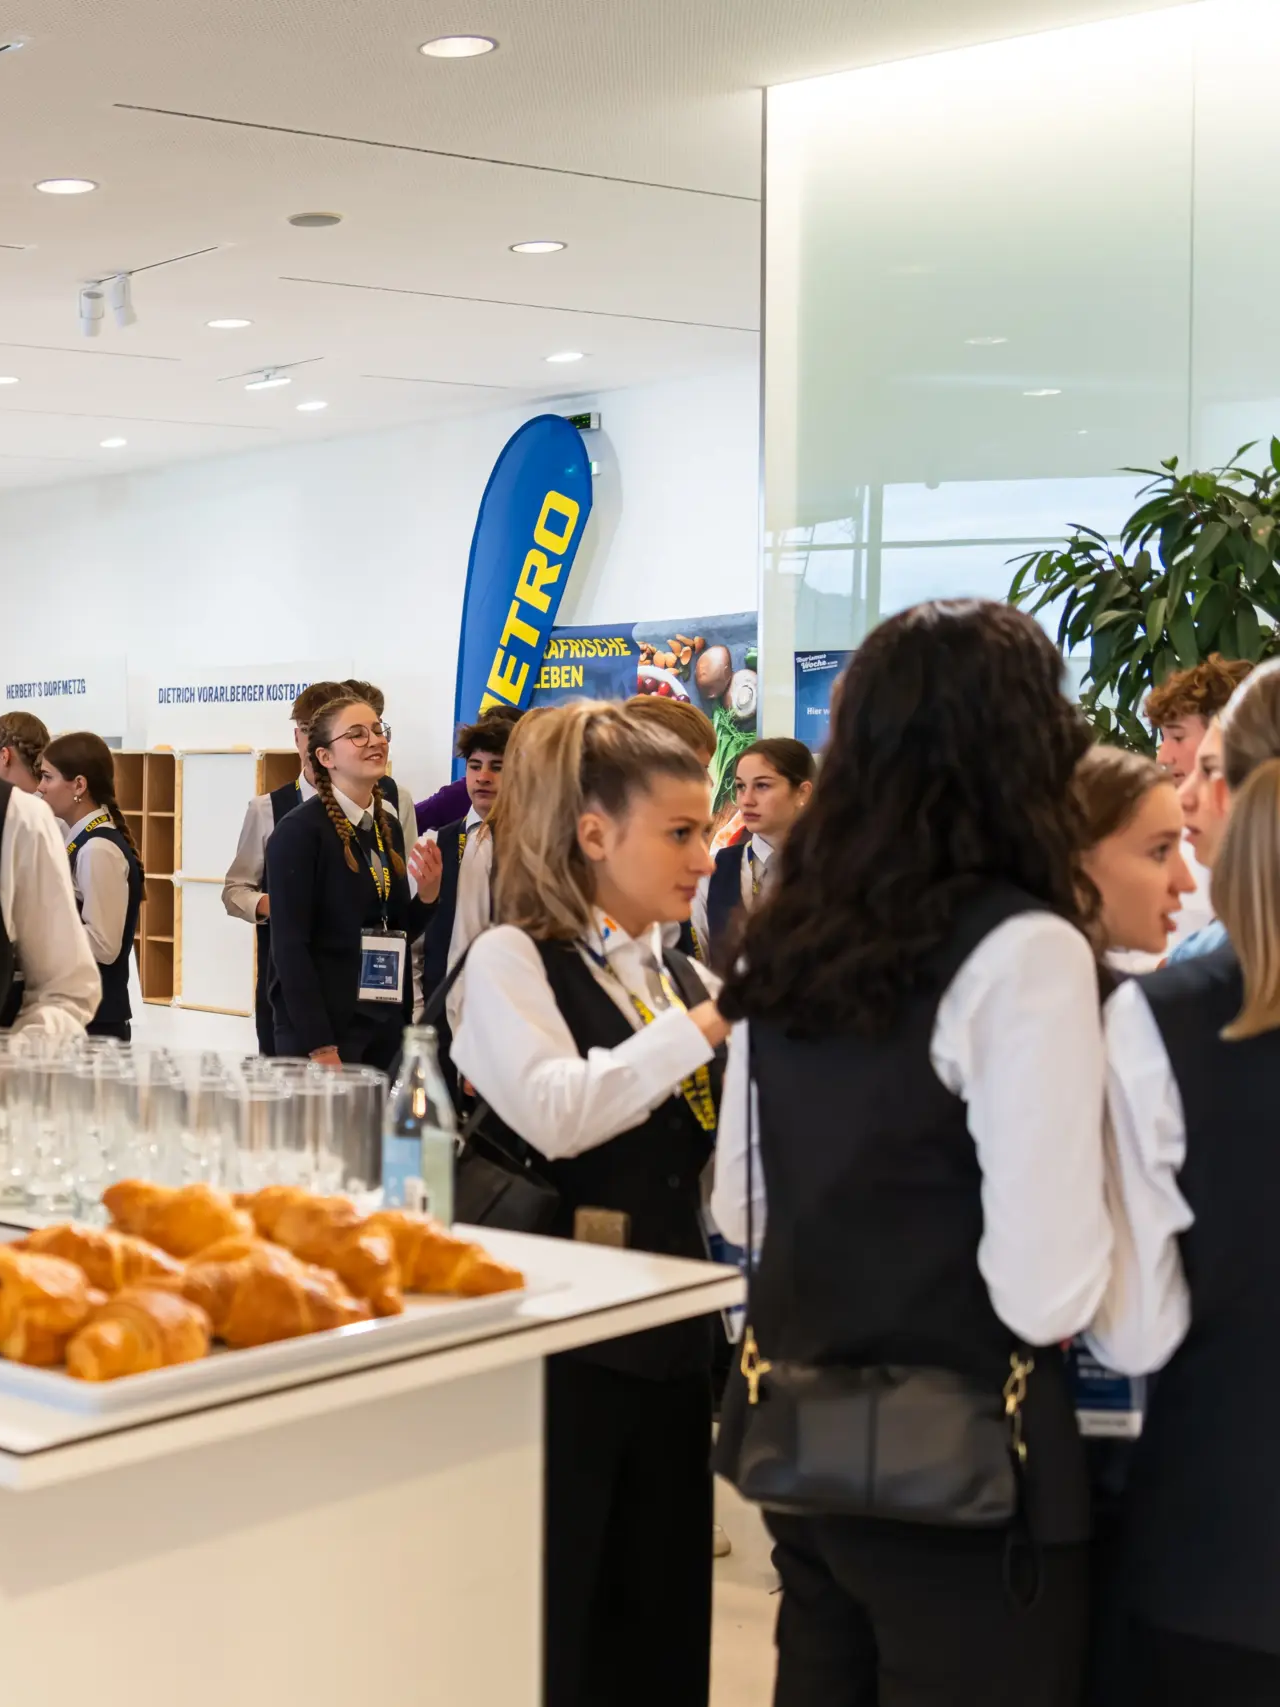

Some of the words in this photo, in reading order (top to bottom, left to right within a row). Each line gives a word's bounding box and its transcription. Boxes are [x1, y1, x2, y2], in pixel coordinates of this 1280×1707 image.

[6, 681, 43, 700] HERBERT'S
[43, 678, 87, 698] DORFMETZG
[158, 686, 196, 704] DIETRICH
[197, 684, 264, 703] VORARLBERGER
[266, 681, 312, 701] KOSTBA
[369, 866, 383, 899] METR
